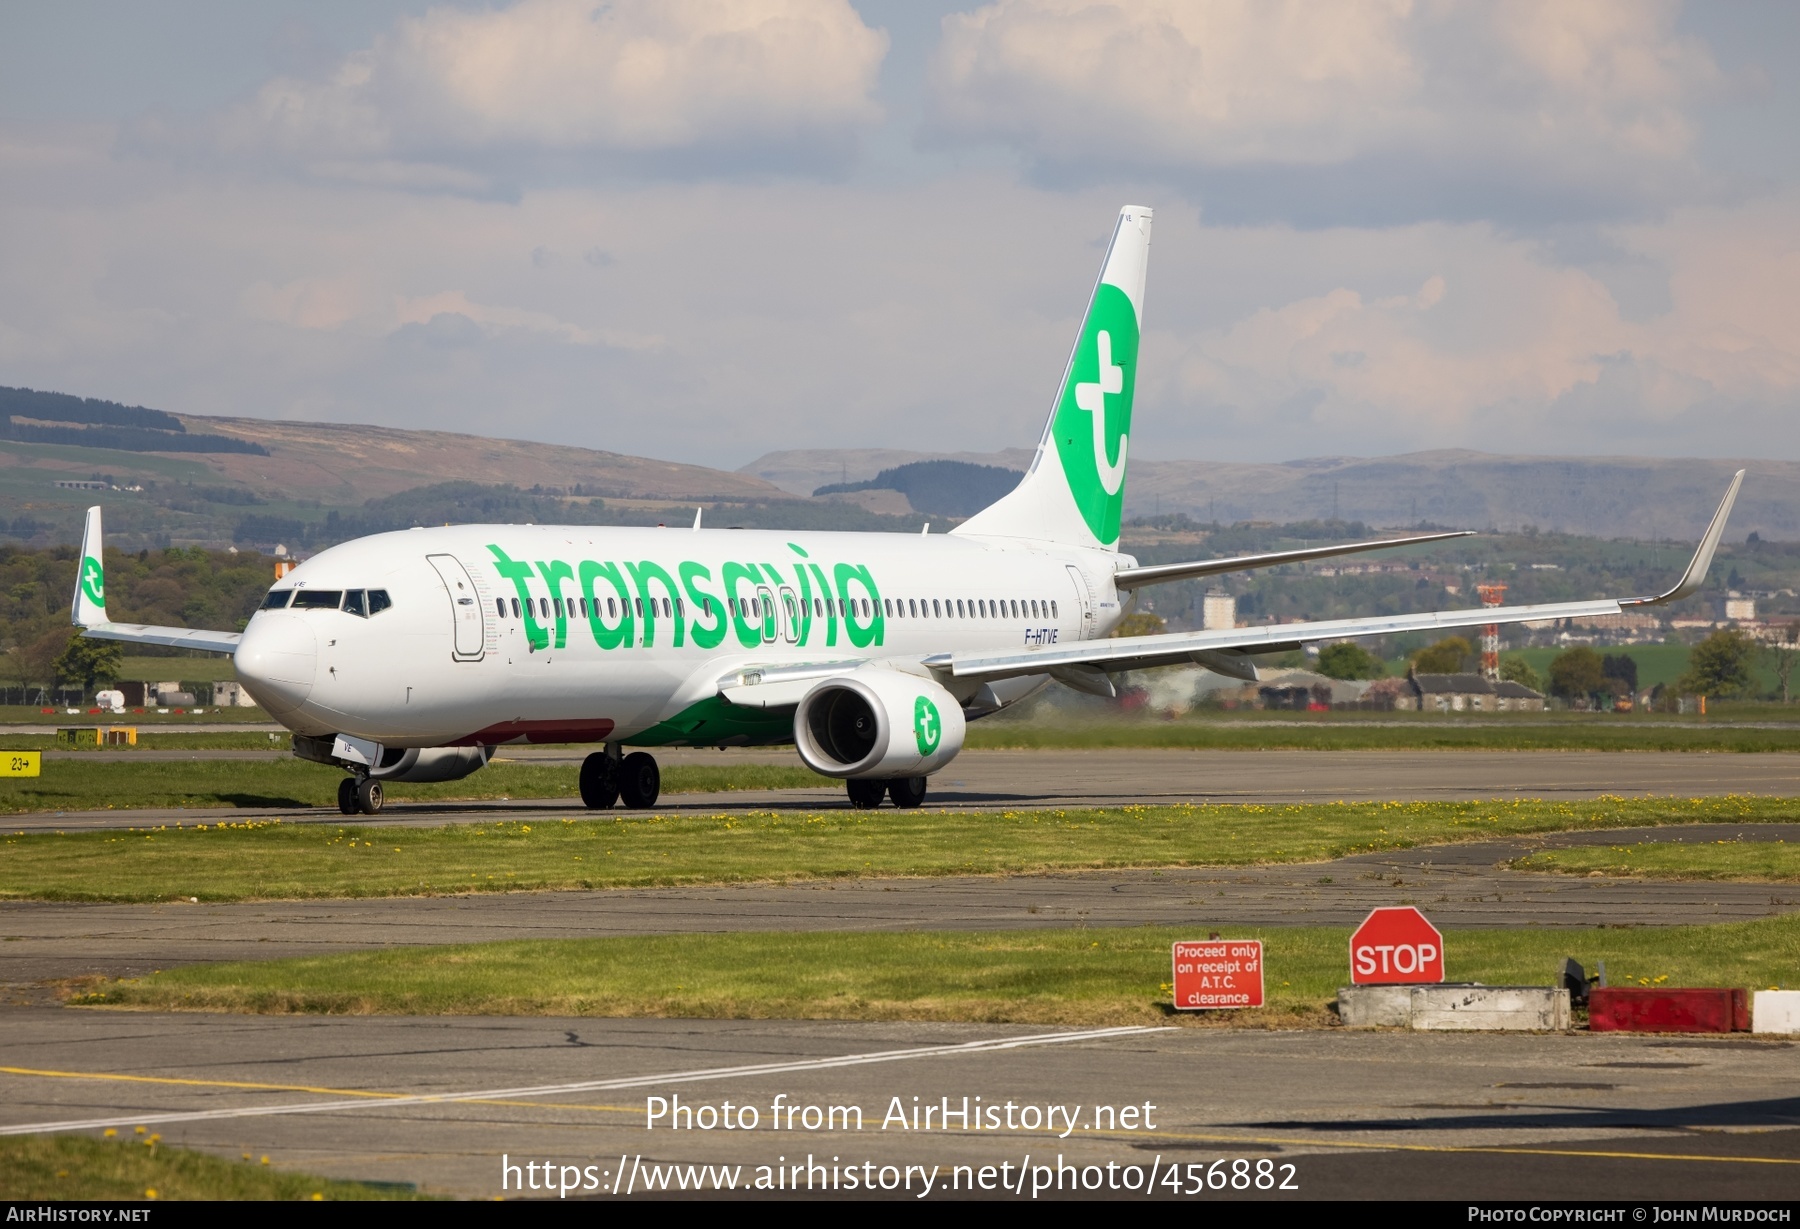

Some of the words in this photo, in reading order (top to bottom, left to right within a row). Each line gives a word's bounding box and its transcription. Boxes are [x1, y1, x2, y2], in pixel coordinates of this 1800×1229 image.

[486, 543, 884, 650] transavia
[1024, 628, 1059, 645] F-HTVE
[344, 742, 352, 753] VE
[11, 757, 23, 771] 23
[1176, 944, 1227, 958] Proceed
[1231, 944, 1258, 959] only
[1177, 963, 1193, 974] on
[1197, 960, 1241, 975] receipt
[1245, 959, 1258, 972] of
[1356, 943, 1437, 976] STOP
[1201, 975, 1236, 989] A.T.C.
[1188, 991, 1250, 1005] clearance
